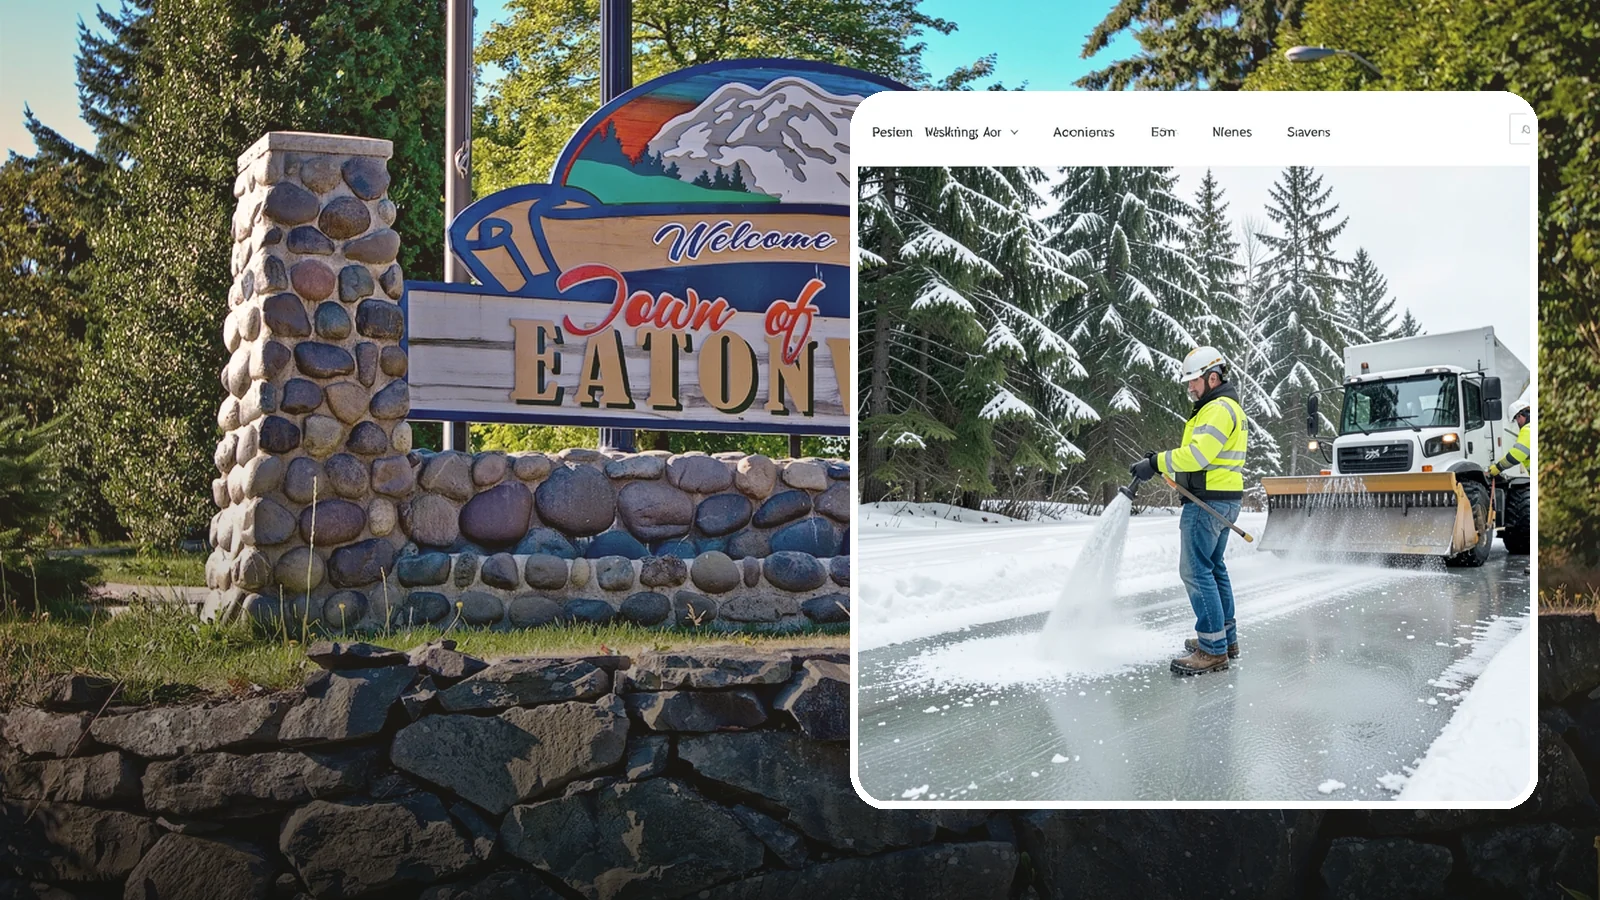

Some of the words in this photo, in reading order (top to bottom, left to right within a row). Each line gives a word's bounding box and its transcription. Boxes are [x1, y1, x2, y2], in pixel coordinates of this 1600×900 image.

[653, 220, 837, 263] Welcome
[557, 263, 736, 337] Town
[765, 278, 826, 366] of
